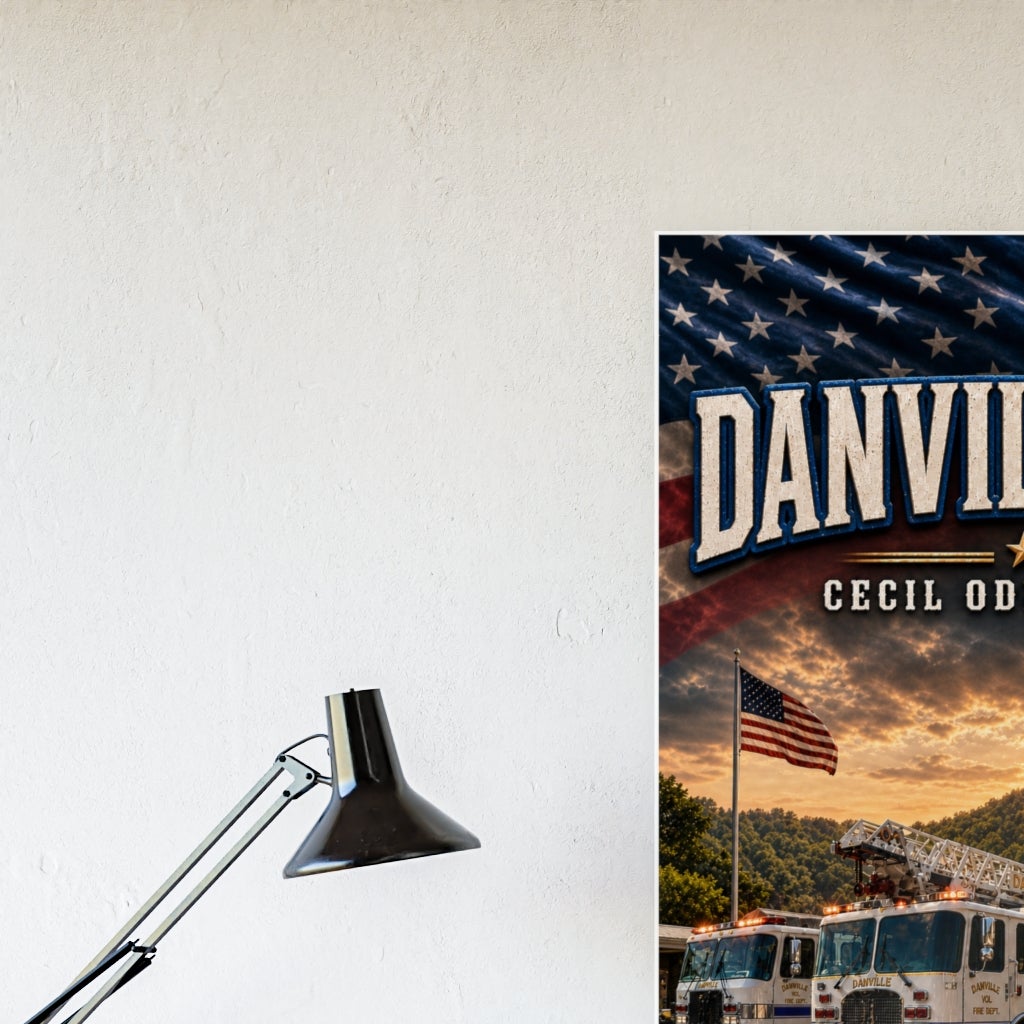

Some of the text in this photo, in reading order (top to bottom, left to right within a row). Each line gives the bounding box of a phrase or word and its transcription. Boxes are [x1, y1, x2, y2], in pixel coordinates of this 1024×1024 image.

[823, 579, 943, 612] CECIL
[852, 977, 892, 988] DANVILLE
[971, 981, 1001, 995] DANVILLE
[972, 1007, 984, 1015] FIRE
